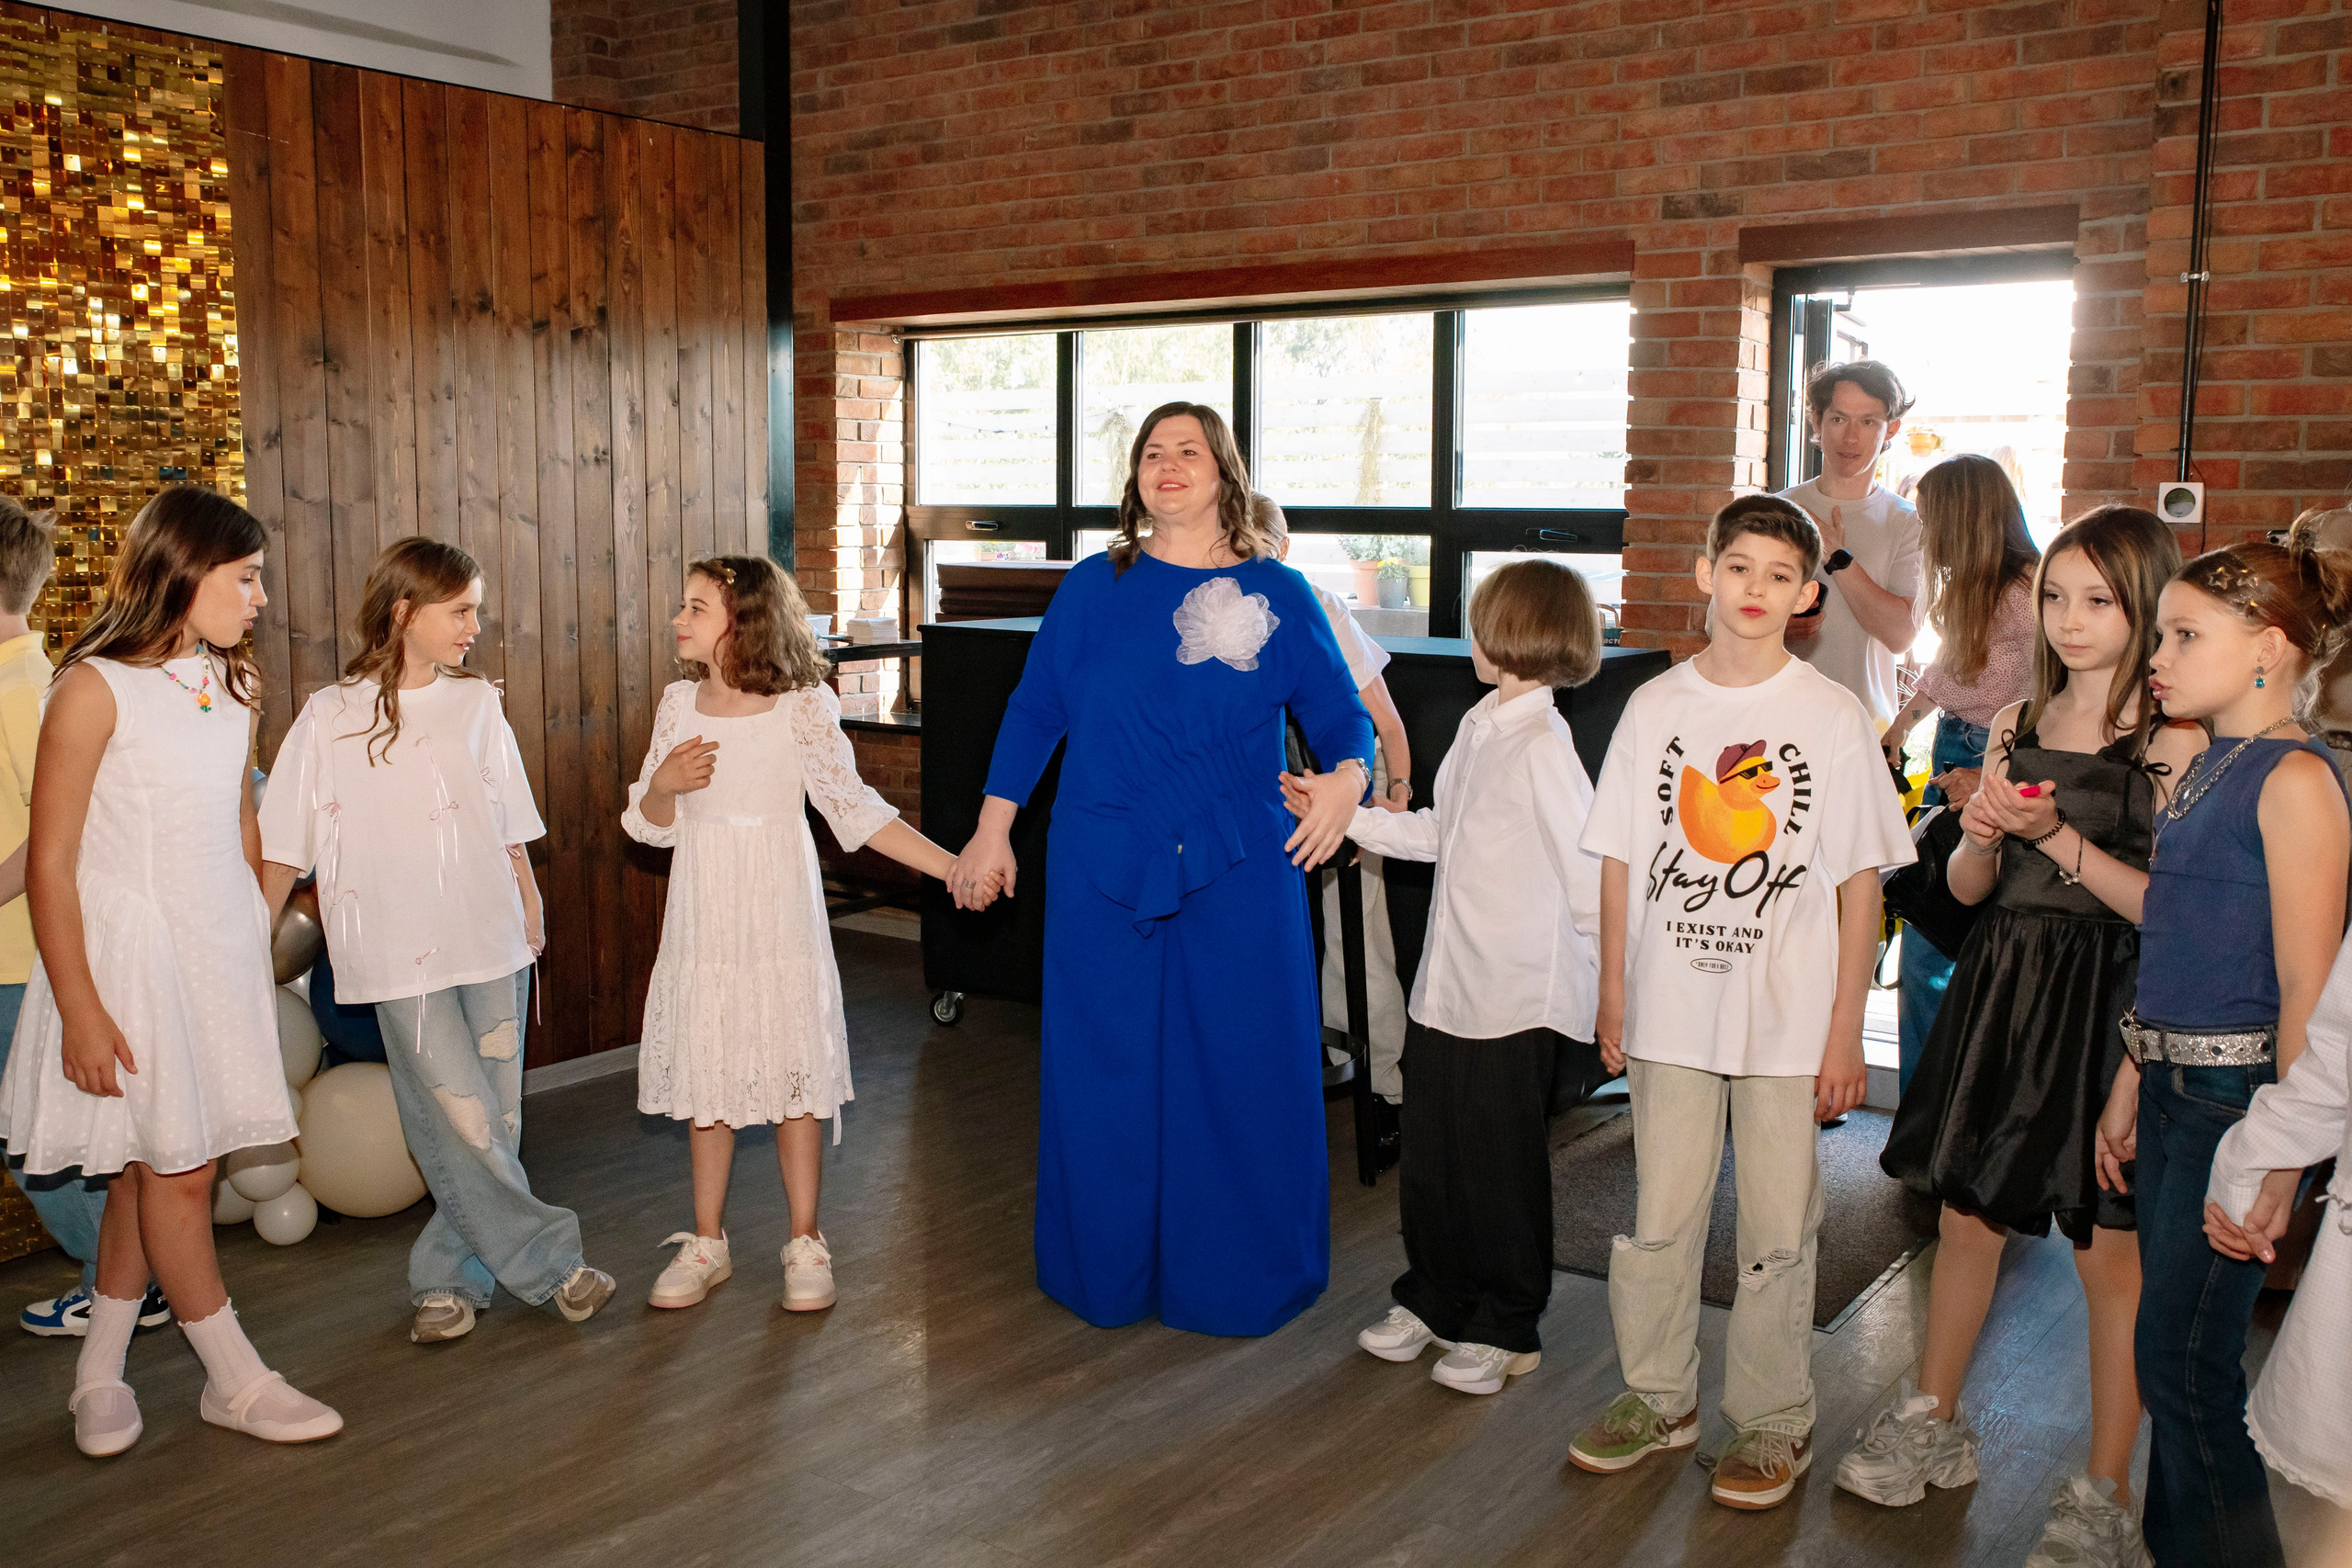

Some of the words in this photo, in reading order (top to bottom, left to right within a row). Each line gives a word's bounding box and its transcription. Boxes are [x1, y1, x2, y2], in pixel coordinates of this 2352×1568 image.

[1657, 736, 1685, 826] SOFT
[1779, 743, 1812, 835] CHILL
[1646, 840, 1718, 913] Stay
[1724, 850, 1807, 919] Off
[1666, 920, 1672, 931] I
[1676, 921, 1727, 937] EXIST
[1731, 927, 1764, 940] AND
[1676, 936, 1710, 951] IT'S
[1715, 940, 1756, 954] OKAY
